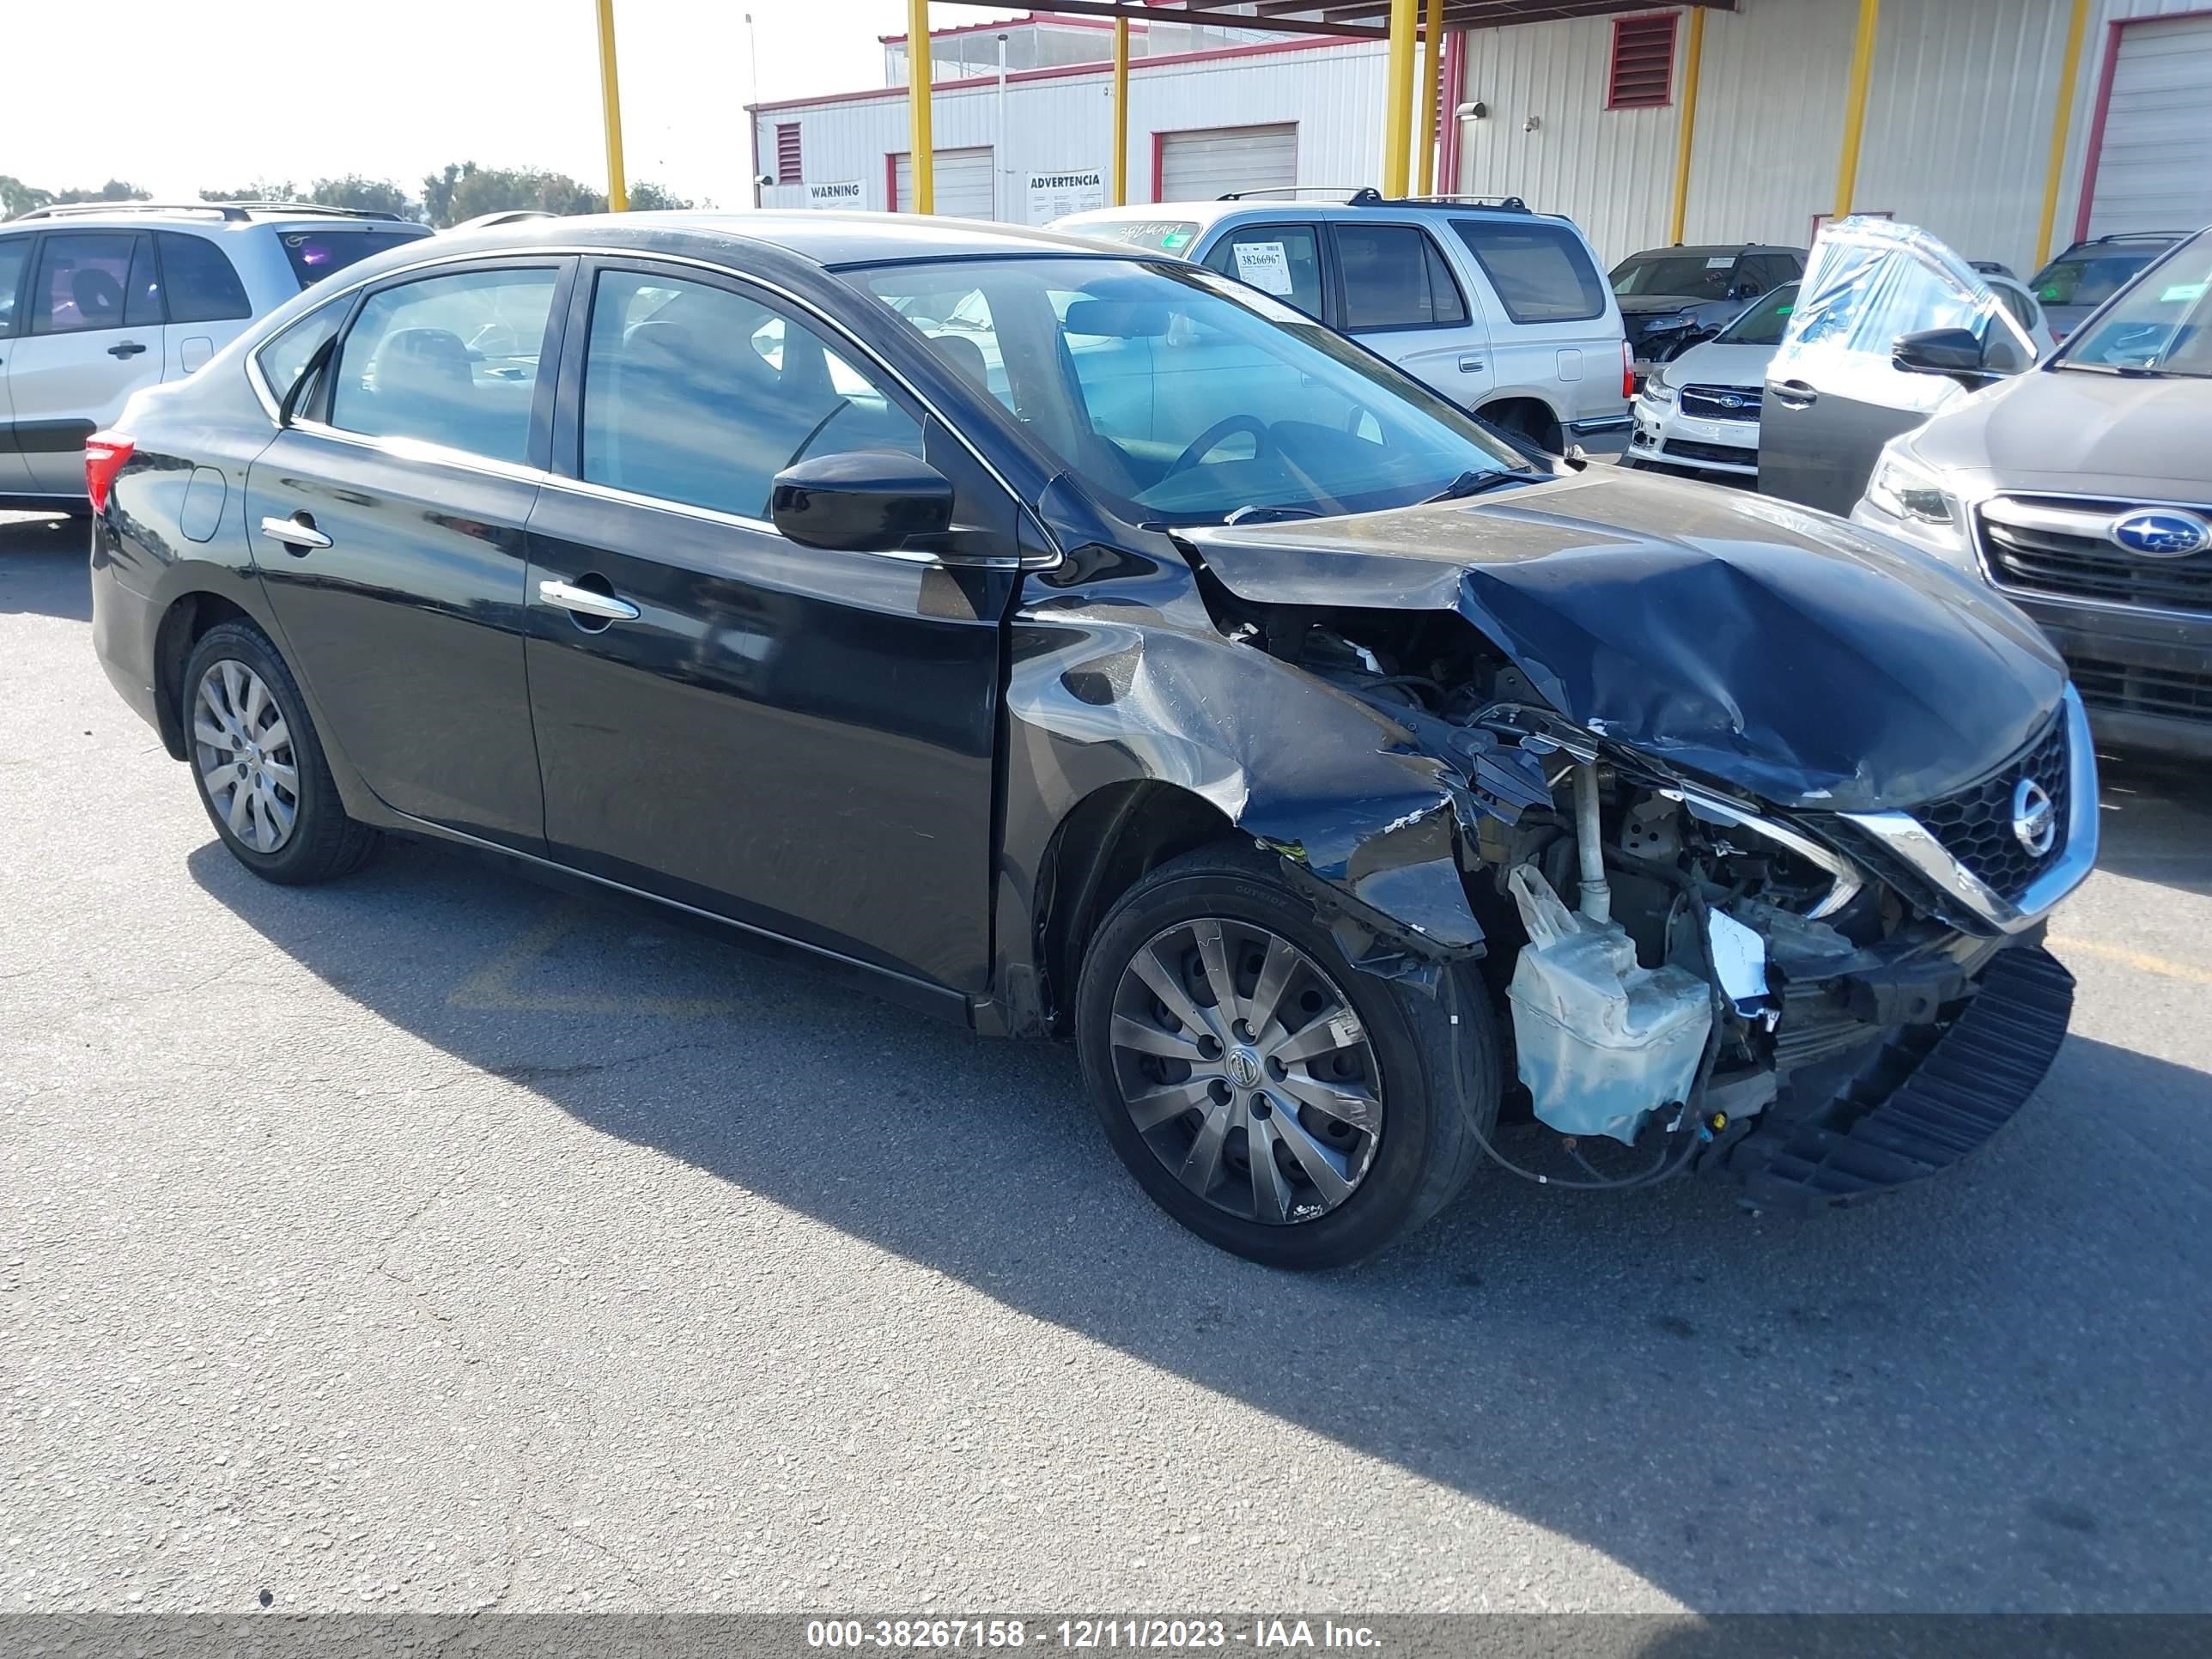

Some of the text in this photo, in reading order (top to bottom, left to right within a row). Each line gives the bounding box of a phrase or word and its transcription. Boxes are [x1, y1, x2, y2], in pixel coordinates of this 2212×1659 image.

[1030, 174, 1100, 189] ADVERTENCIA
[811, 185, 860, 198] WARNING
[1242, 254, 1280, 265] 38266967
